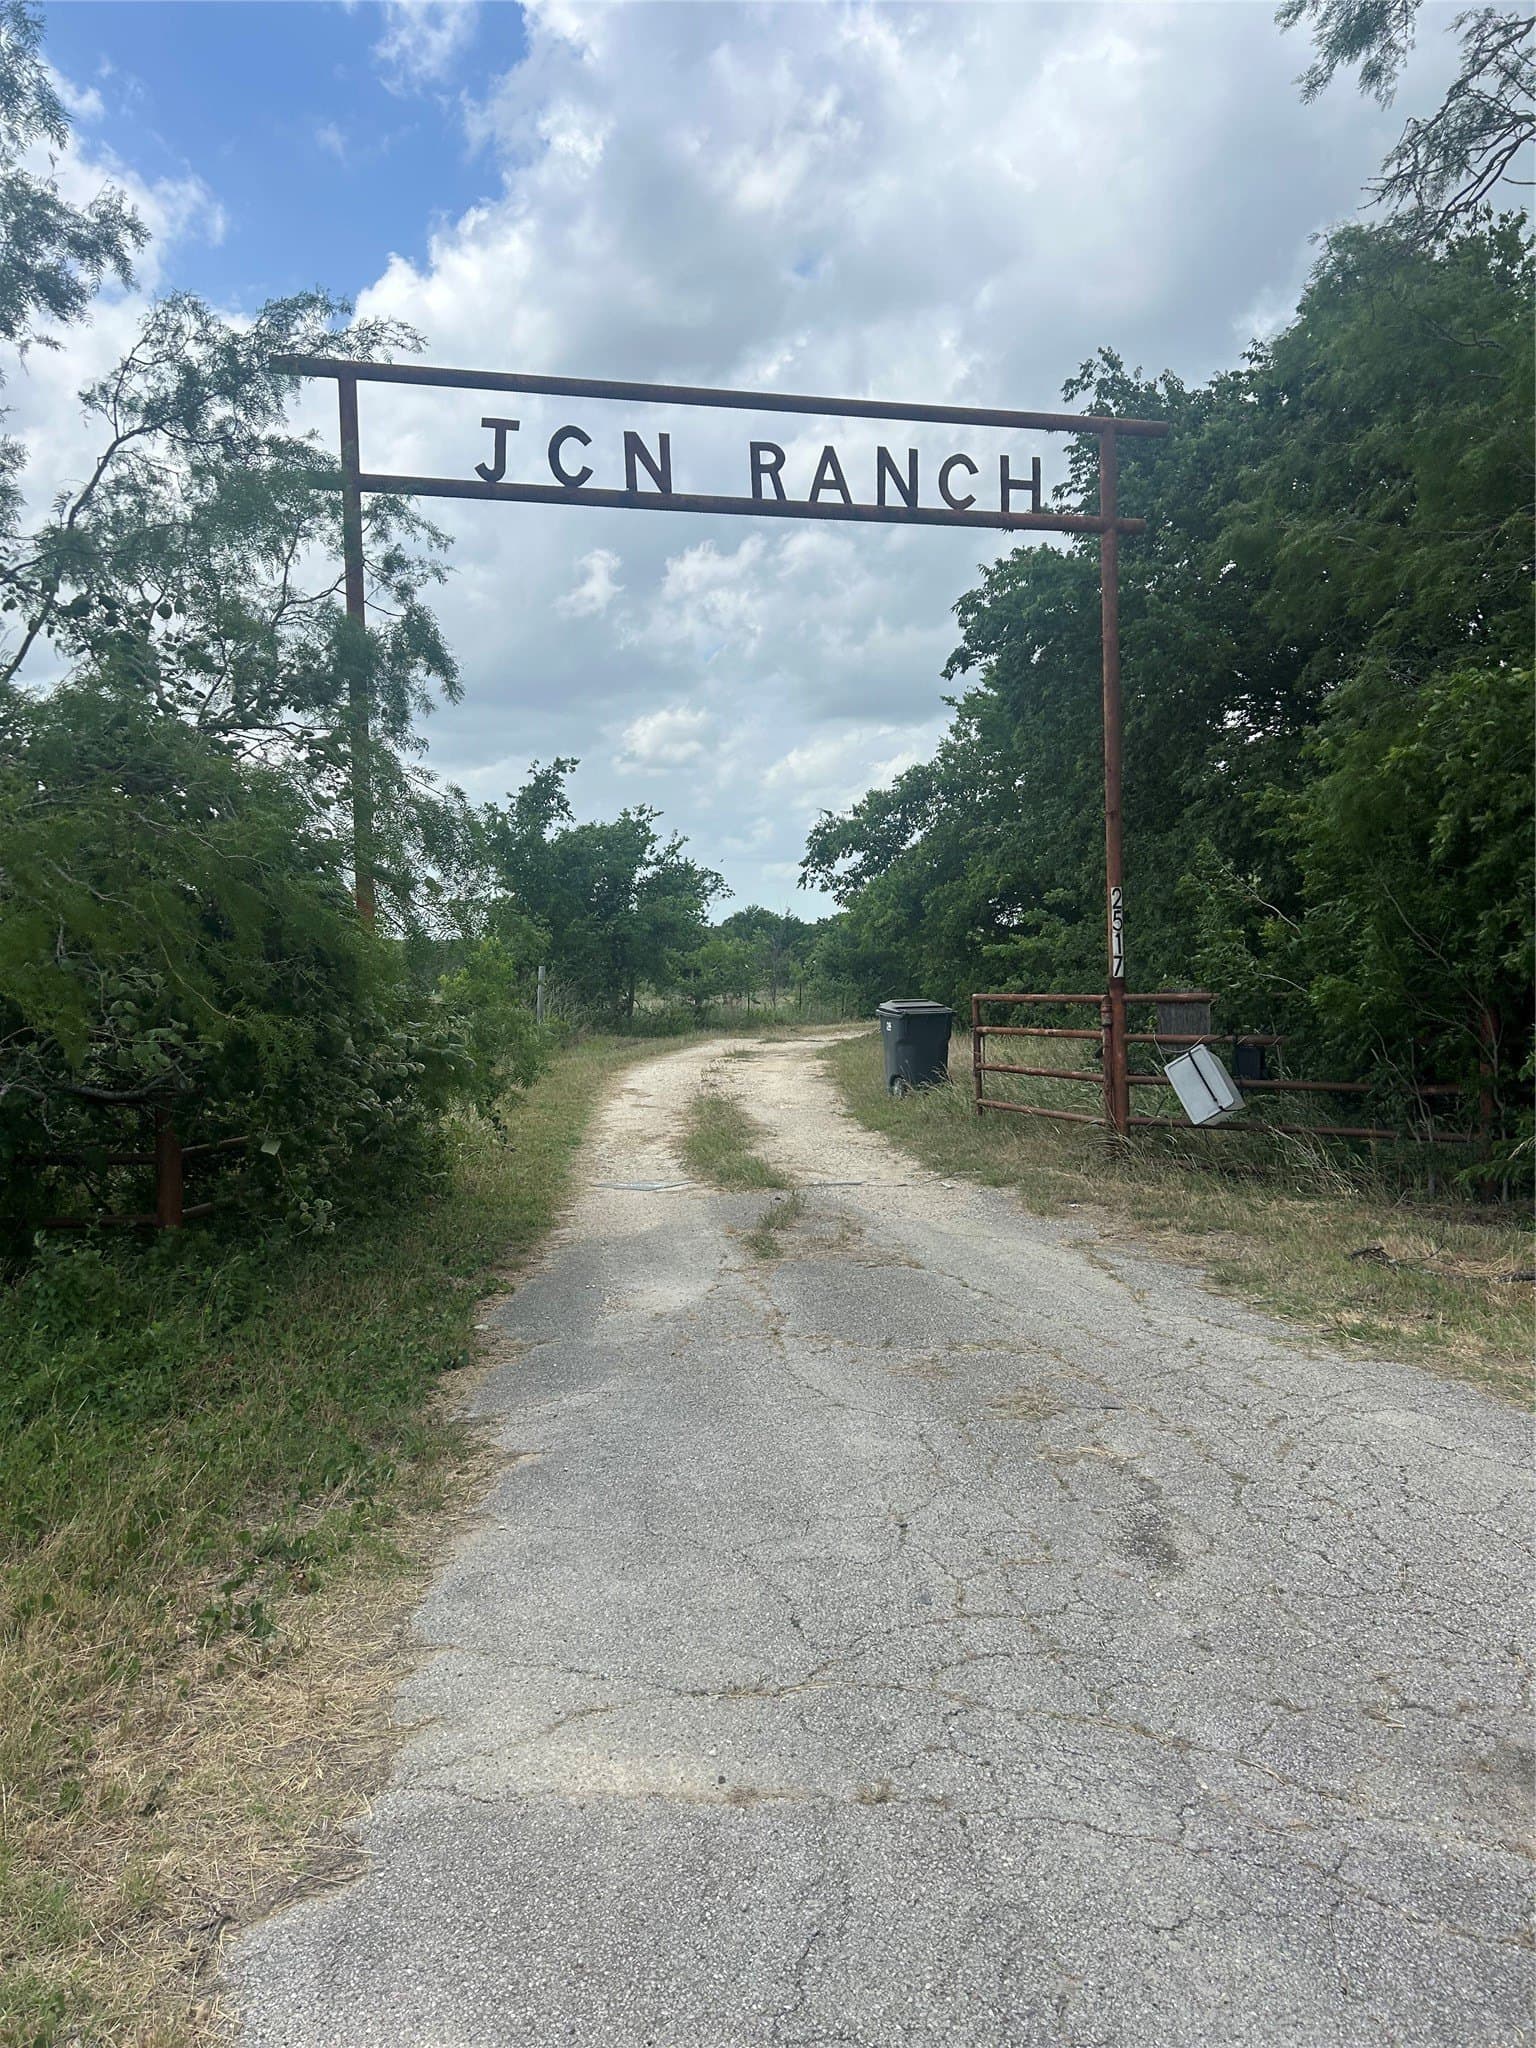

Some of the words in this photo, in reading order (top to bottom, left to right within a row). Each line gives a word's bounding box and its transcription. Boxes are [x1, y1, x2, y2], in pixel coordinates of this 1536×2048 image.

[474, 417, 673, 494] JCN
[749, 441, 1042, 514] RANCH
[1111, 887, 1123, 977] 2517
